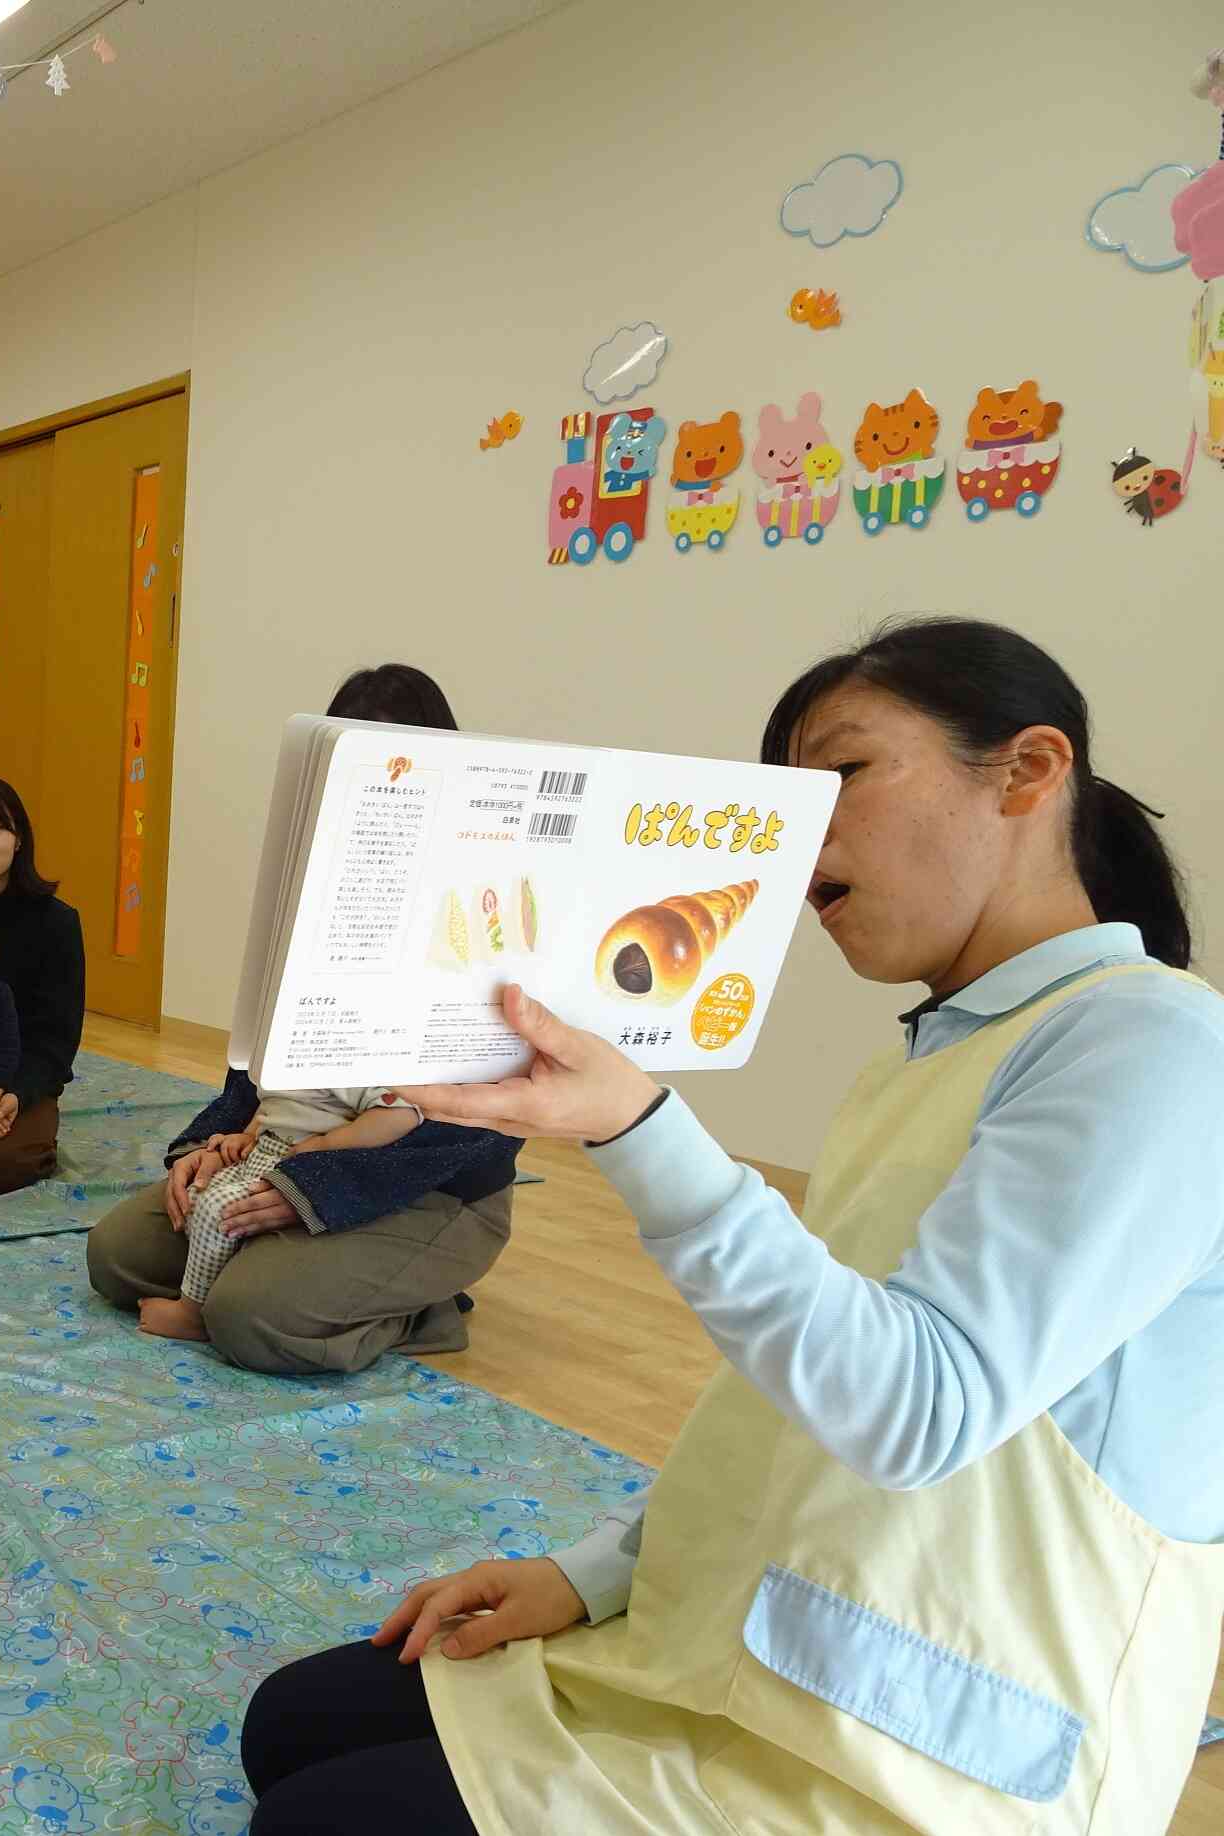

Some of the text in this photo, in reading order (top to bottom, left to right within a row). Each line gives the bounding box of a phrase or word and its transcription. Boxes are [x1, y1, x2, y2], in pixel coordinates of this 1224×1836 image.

[625, 801, 784, 854] ぱんですよ
[618, 1031, 673, 1046] 大森裕子
